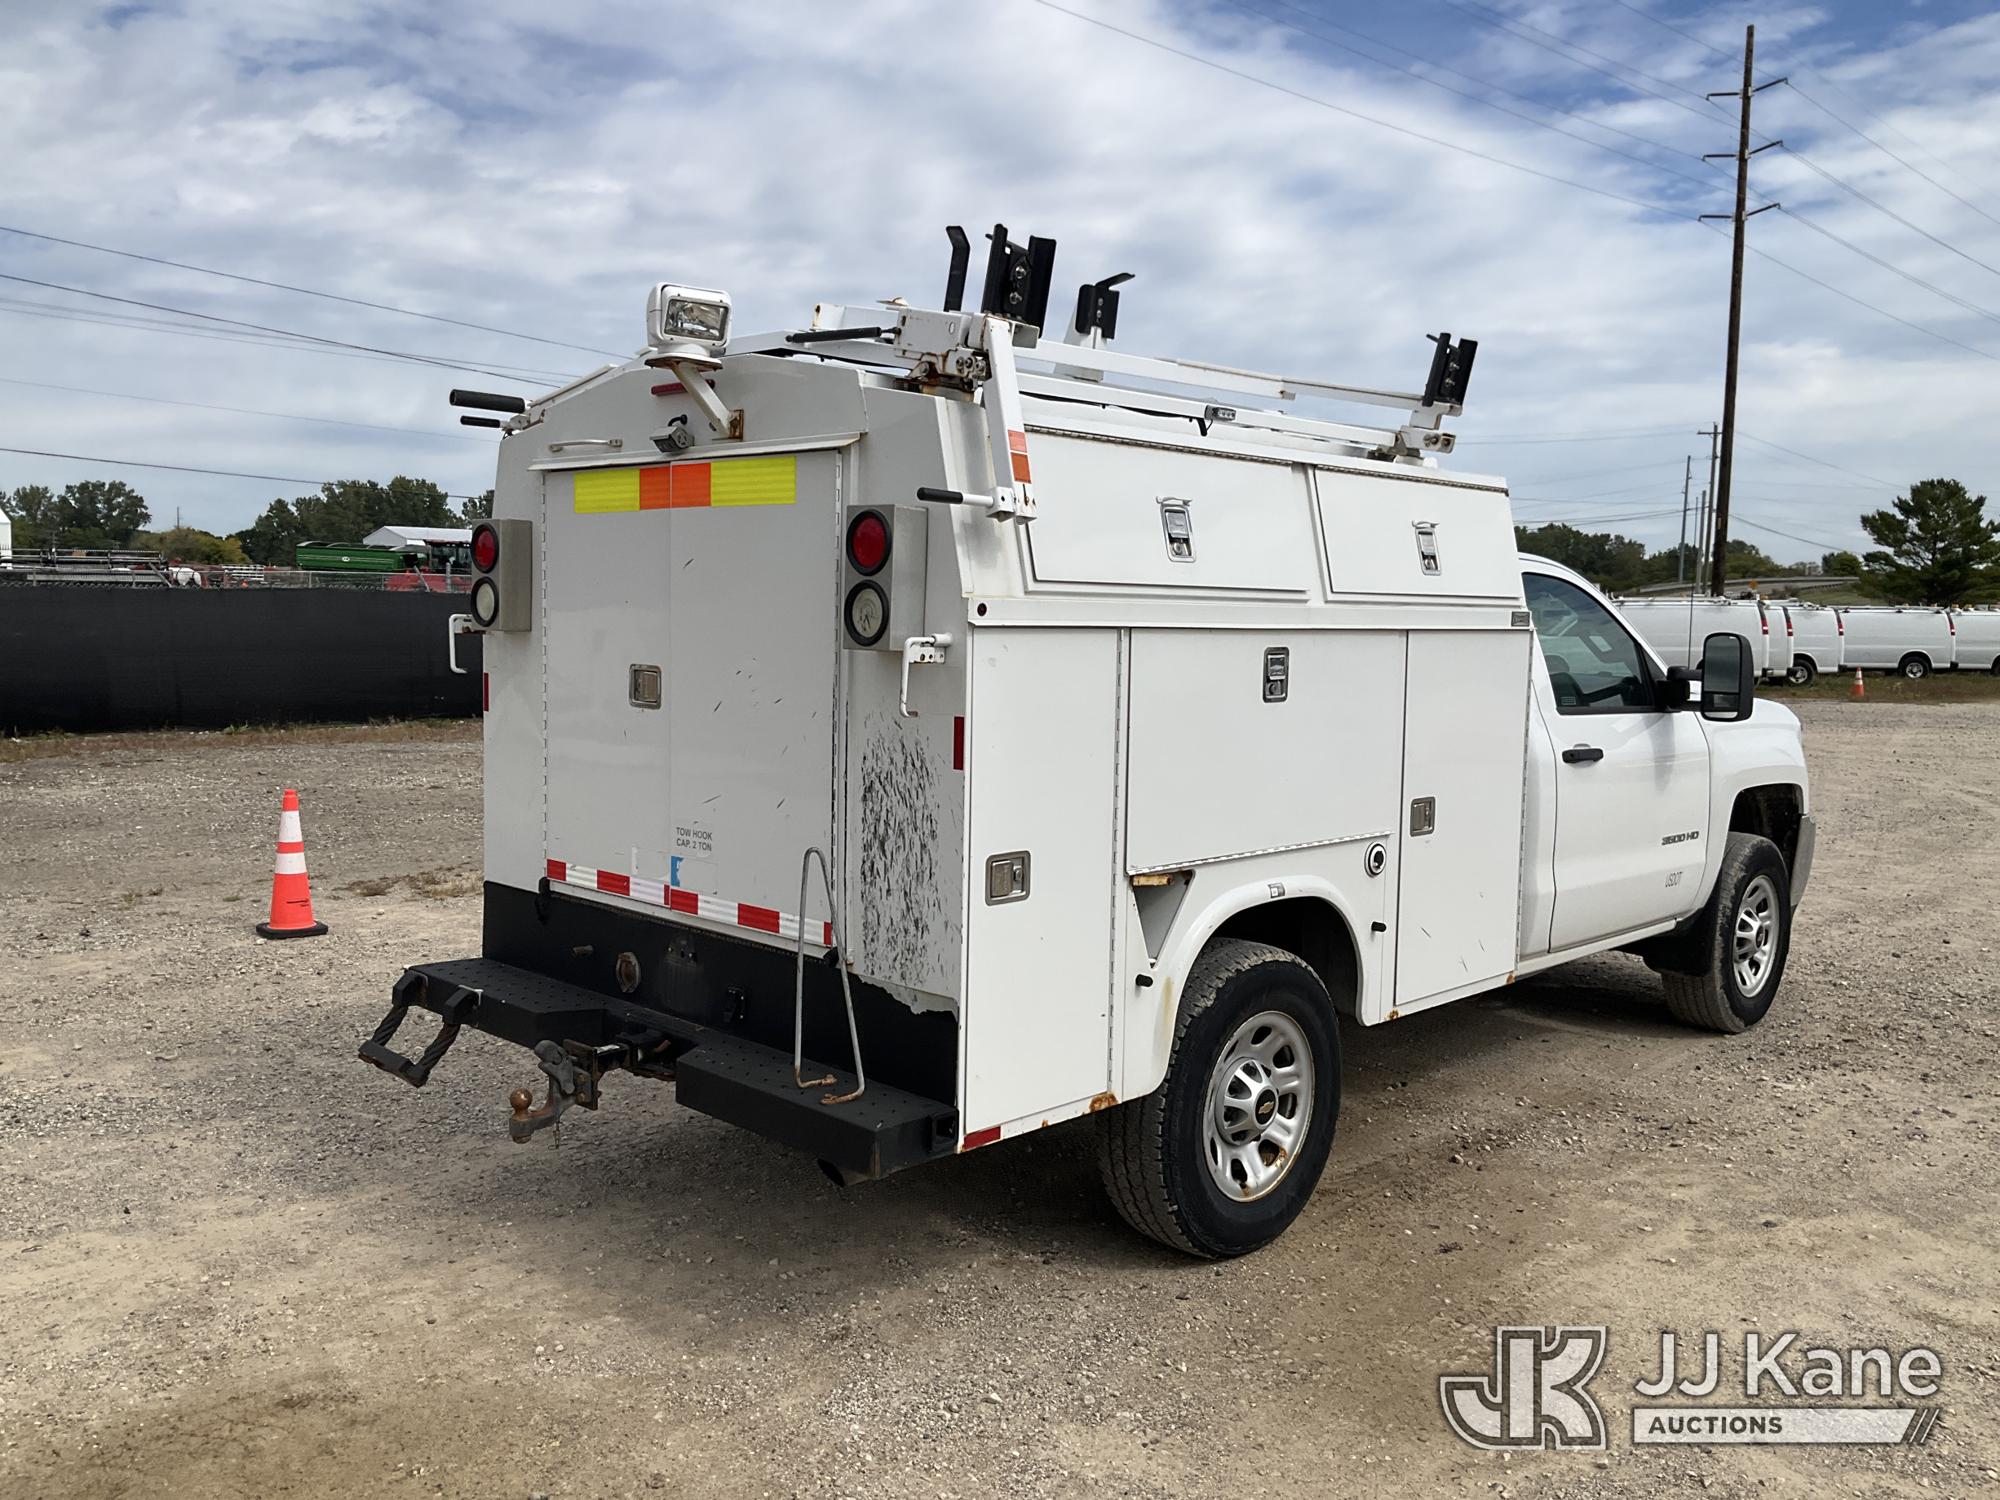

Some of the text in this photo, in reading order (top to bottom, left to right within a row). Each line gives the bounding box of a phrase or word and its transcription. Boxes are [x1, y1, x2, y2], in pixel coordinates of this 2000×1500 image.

[676, 827, 713, 841] TOW HOOK
[1661, 831, 1699, 846] 3500 HD
[692, 841, 697, 849] 2
[698, 842, 712, 851] TON
